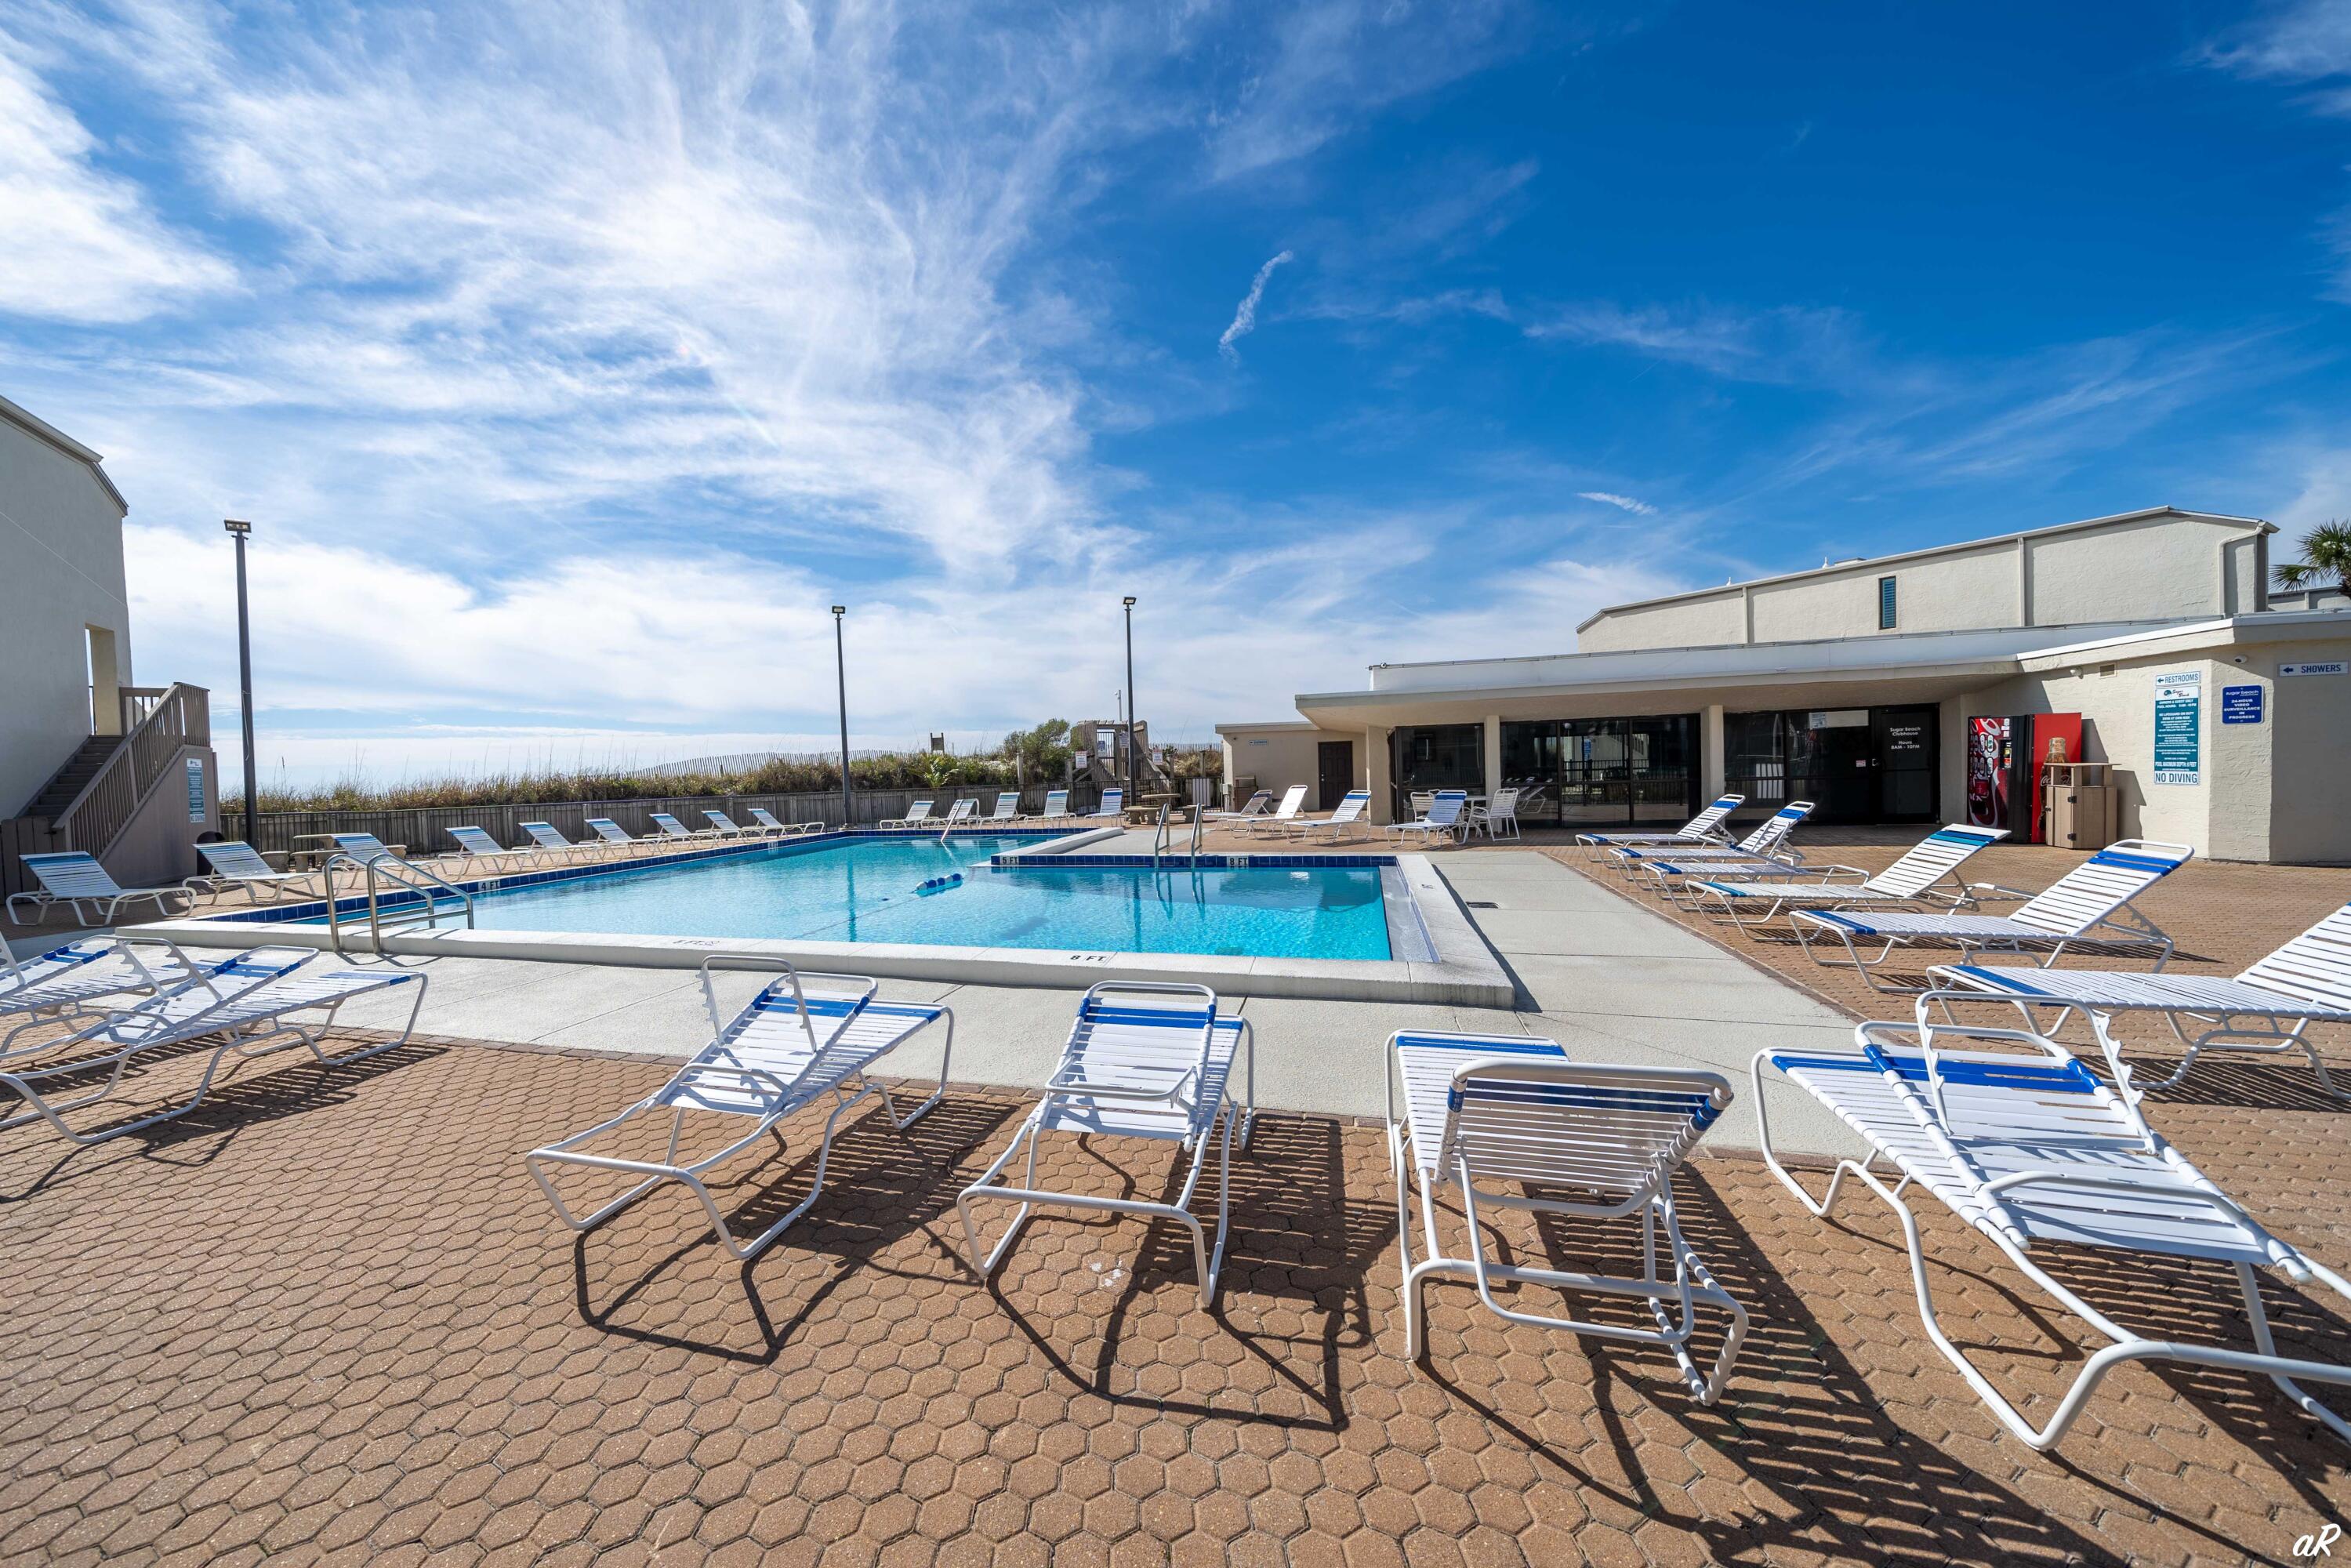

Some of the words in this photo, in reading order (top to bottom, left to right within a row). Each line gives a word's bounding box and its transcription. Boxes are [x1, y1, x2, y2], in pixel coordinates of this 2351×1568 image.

[2301, 664, 2341, 673] SHOWERS
[2165, 673, 2198, 683] RESTROOMS
[2156, 773, 2166, 782] NO
[2169, 773, 2197, 783] DIVING
